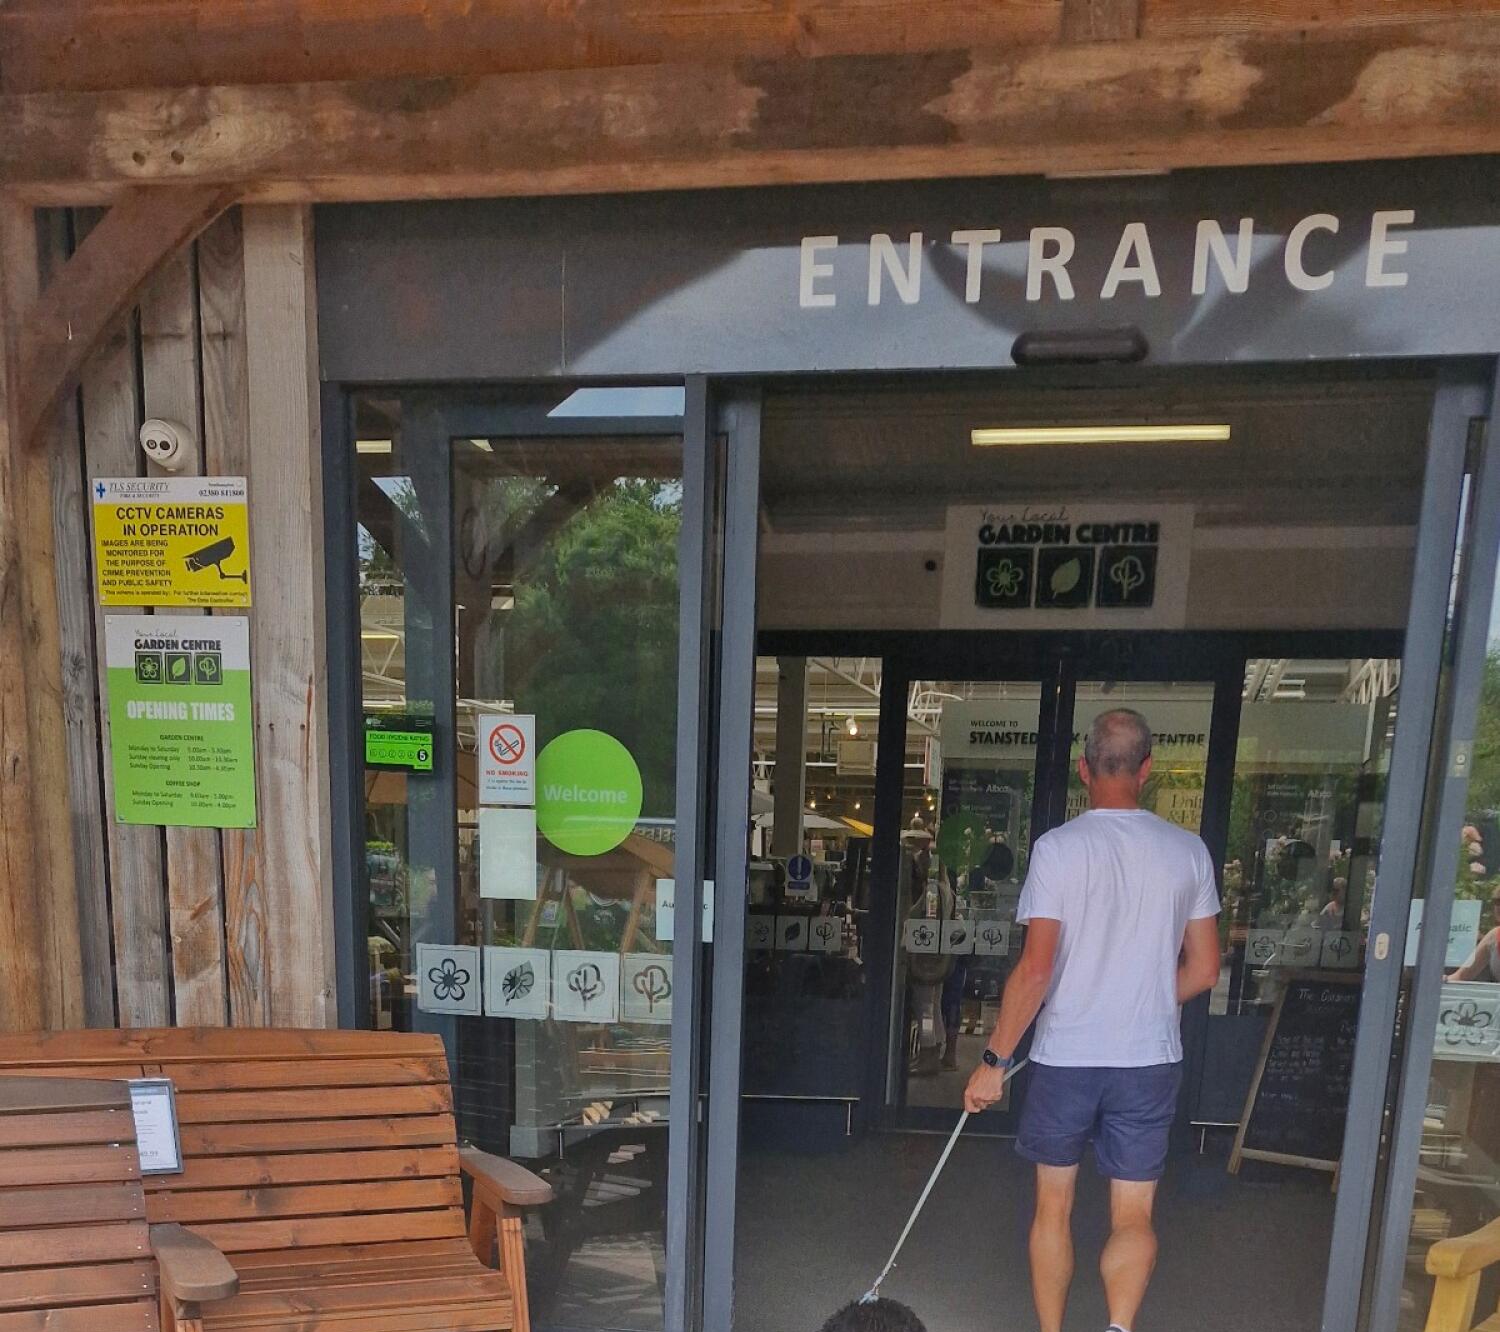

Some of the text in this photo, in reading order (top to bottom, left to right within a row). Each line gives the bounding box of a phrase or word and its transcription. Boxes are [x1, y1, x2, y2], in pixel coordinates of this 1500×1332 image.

[799, 209, 1416, 308] ENTRANCE
[126, 481, 170, 491] SECURITY
[116, 507, 224, 520] CCTV CAMERAS
[123, 524, 219, 536] IN OPERATION
[978, 522, 1160, 544] GARDEN CENTRE
[102, 579, 172, 587] AND PUBLIC SAFETY
[134, 639, 221, 650] GARDEN CENTRE
[127, 701, 235, 720] OPENING TIMES
[970, 731, 1039, 745] STANSTED
[419, 750, 426, 760] 5
[544, 785, 628, 803] Welcome
